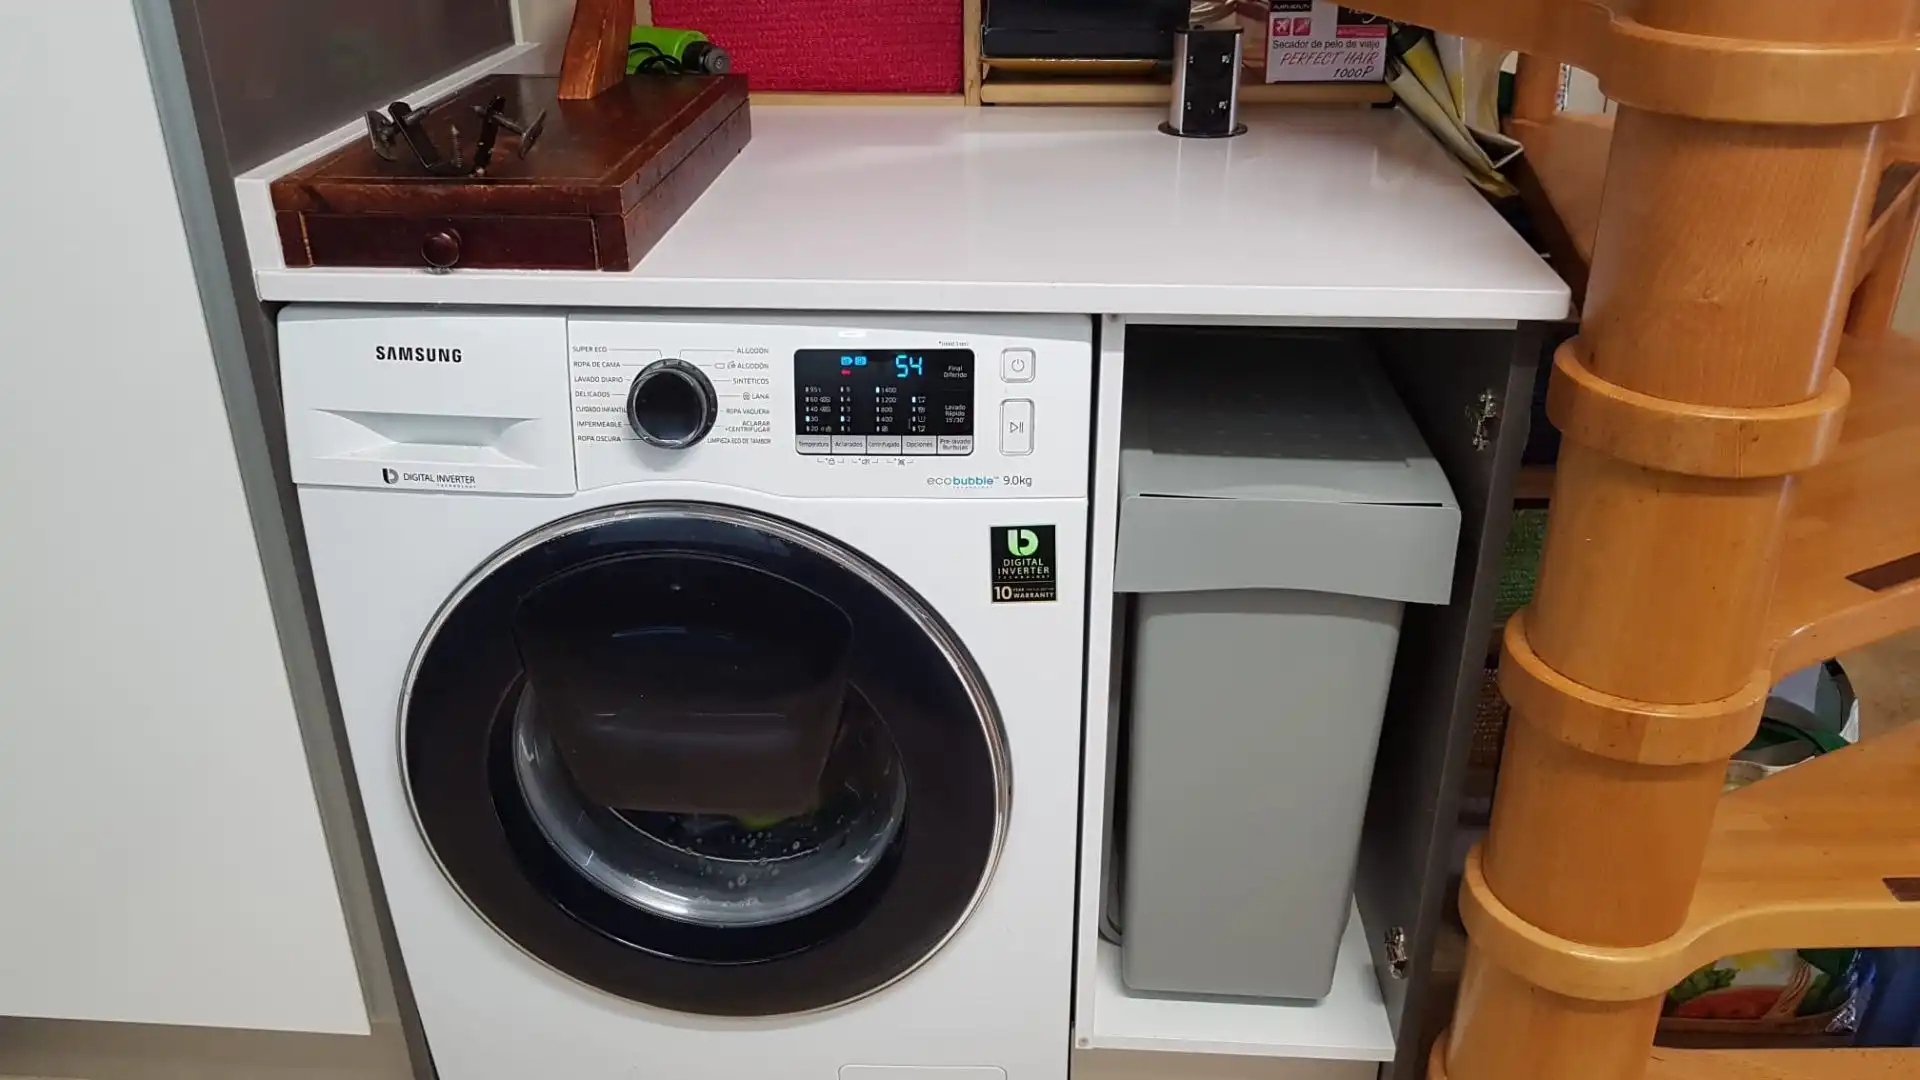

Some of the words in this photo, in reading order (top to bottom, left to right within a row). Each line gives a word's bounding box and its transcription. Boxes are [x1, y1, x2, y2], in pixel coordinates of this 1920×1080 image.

[1272, 40, 1309, 49] Secador
[1310, 40, 1322, 49] de
[1324, 41, 1343, 50] pelo
[1346, 41, 1357, 49] de
[1359, 40, 1379, 50] viaje
[1280, 51, 1344, 66] PERFECT
[1344, 51, 1379, 64] HAIR
[376, 346, 462, 363] SAMSUNG
[896, 354, 922, 378] 54
[404, 473, 435, 482] DIGITAL
[437, 474, 475, 484] INVERTER
[1003, 476, 1032, 487] 9.0kg
[1004, 558, 1044, 566] DIGITAL
[998, 566, 1050, 575] INVERTER
[994, 586, 1012, 600] 10
